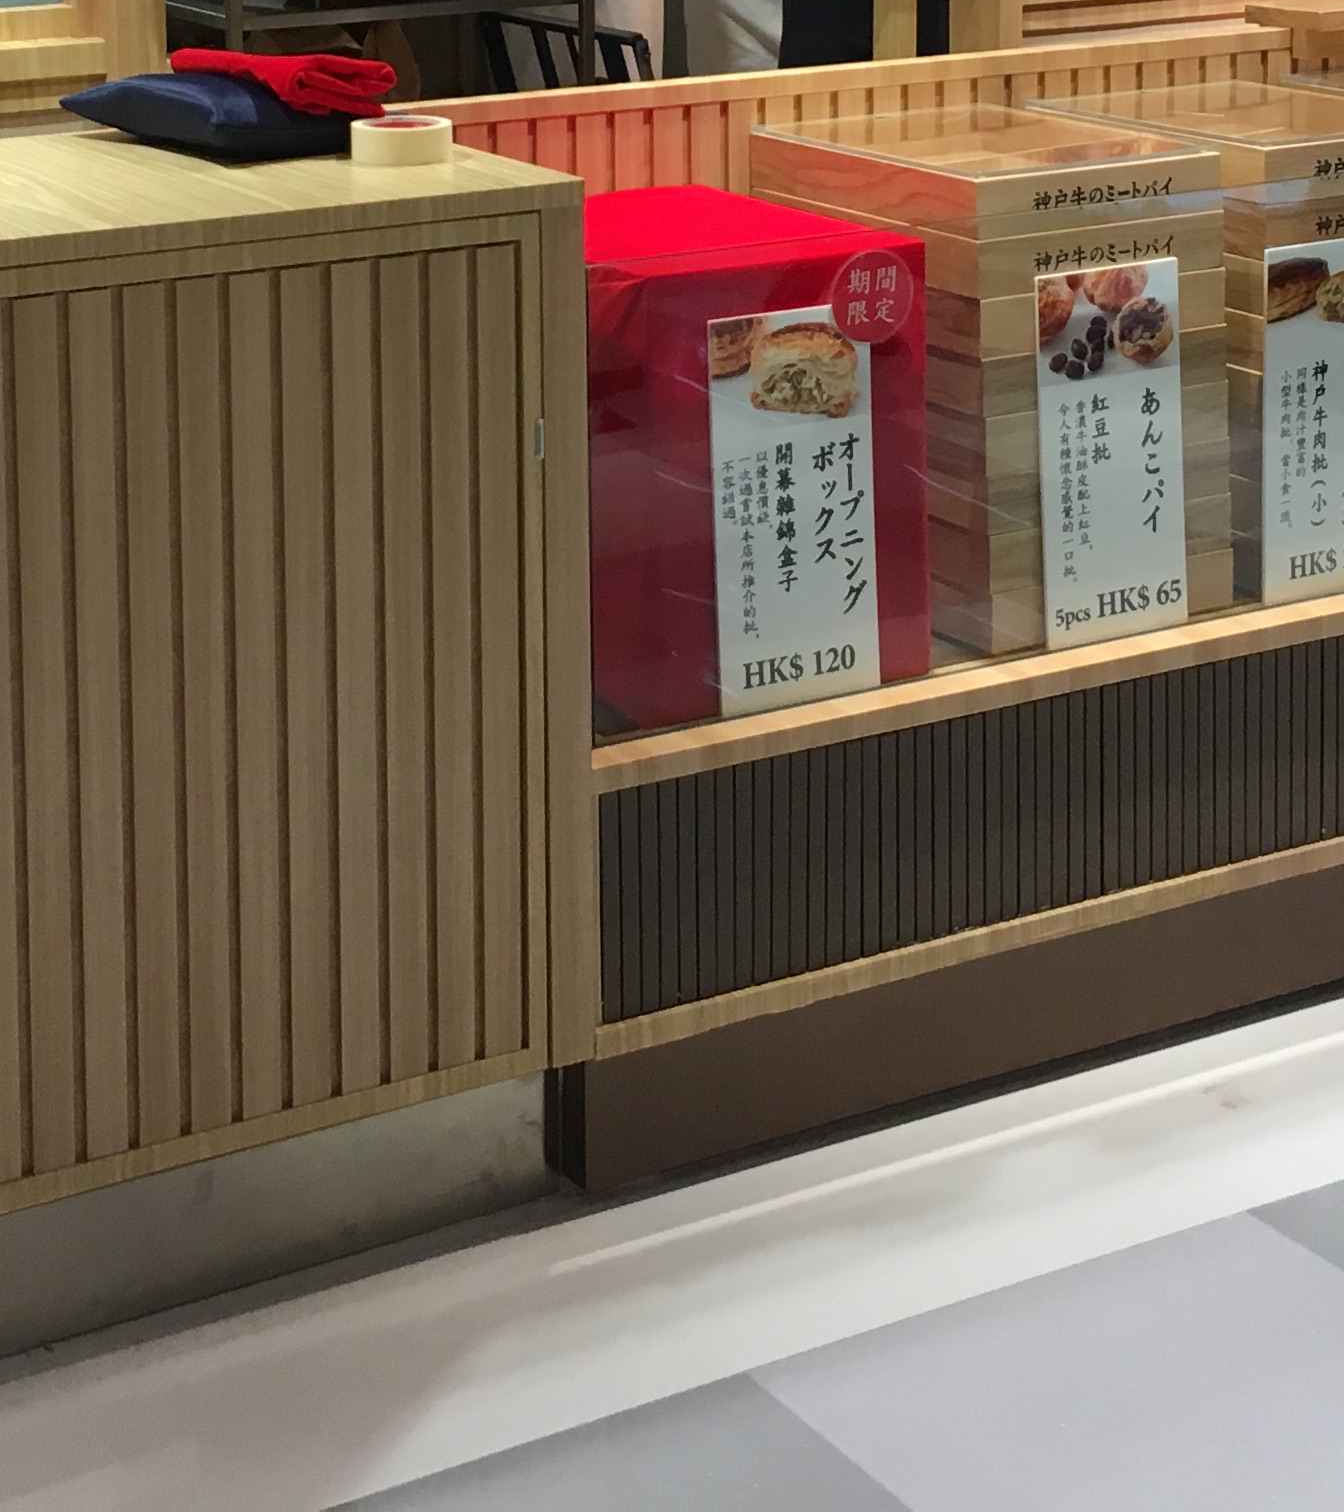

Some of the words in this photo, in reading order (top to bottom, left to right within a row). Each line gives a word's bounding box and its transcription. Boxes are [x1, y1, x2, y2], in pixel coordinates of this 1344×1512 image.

[847, 264, 898, 296] 期間
[846, 296, 896, 326] 限定
[1091, 393, 1111, 465] 紅豆批
[1141, 387, 1165, 534] あんこパイ
[812, 441, 838, 563] ボックス
[838, 433, 867, 615] オープニング
[1289, 549, 1337, 581] HK$
[1055, 606, 1092, 631] 5pcs
[1097, 584, 1151, 620] HK$
[1156, 578, 1183, 605] 65
[742, 653, 805, 691] HK$
[813, 644, 856, 677] 120
